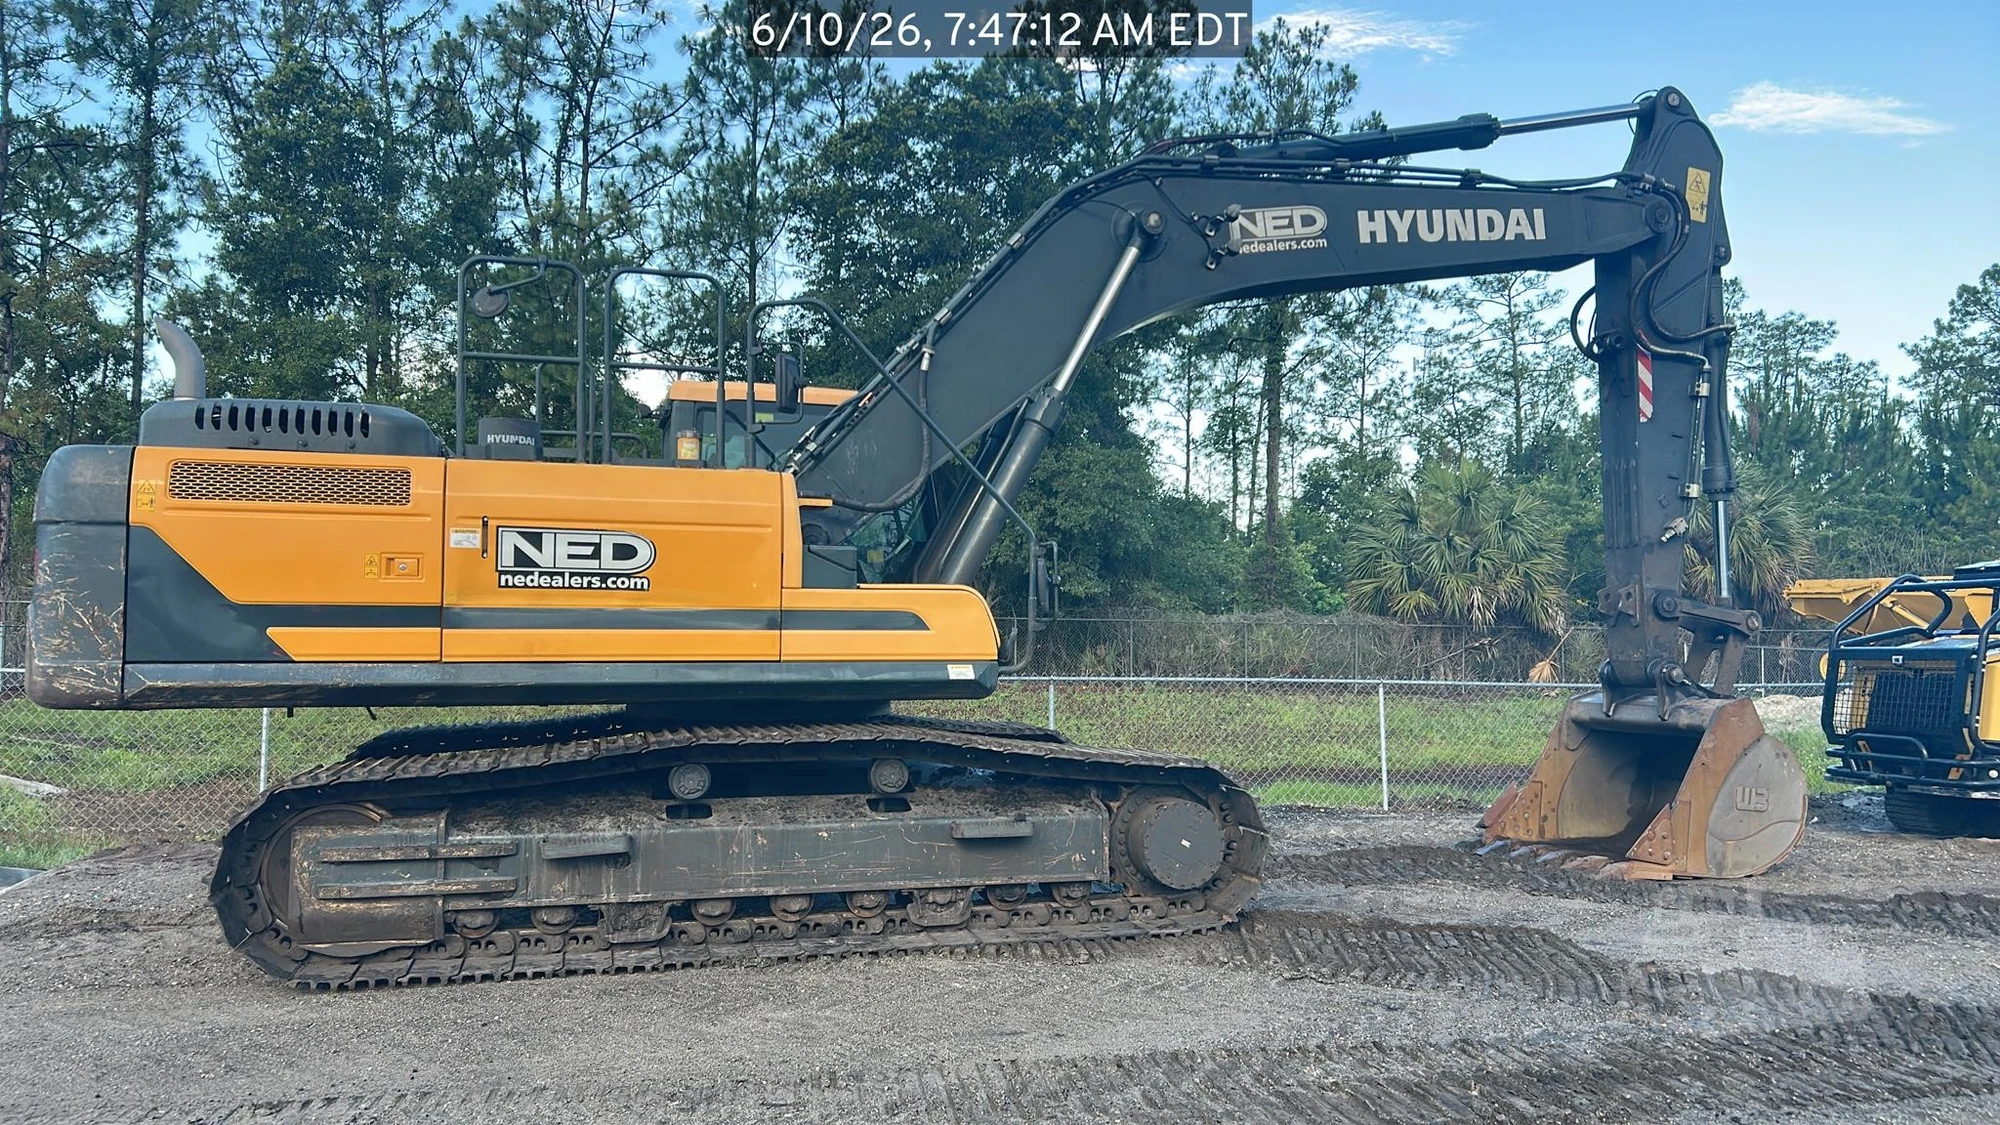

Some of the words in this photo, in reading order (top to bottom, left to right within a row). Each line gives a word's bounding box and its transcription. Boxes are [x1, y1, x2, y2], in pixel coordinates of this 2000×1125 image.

[1231, 208, 1325, 240] NED
[1357, 208, 1546, 244] HYUNDAI
[487, 434, 535, 446] HYUNDAI
[501, 531, 653, 569] NED
[499, 572, 650, 590] nedealers.com
